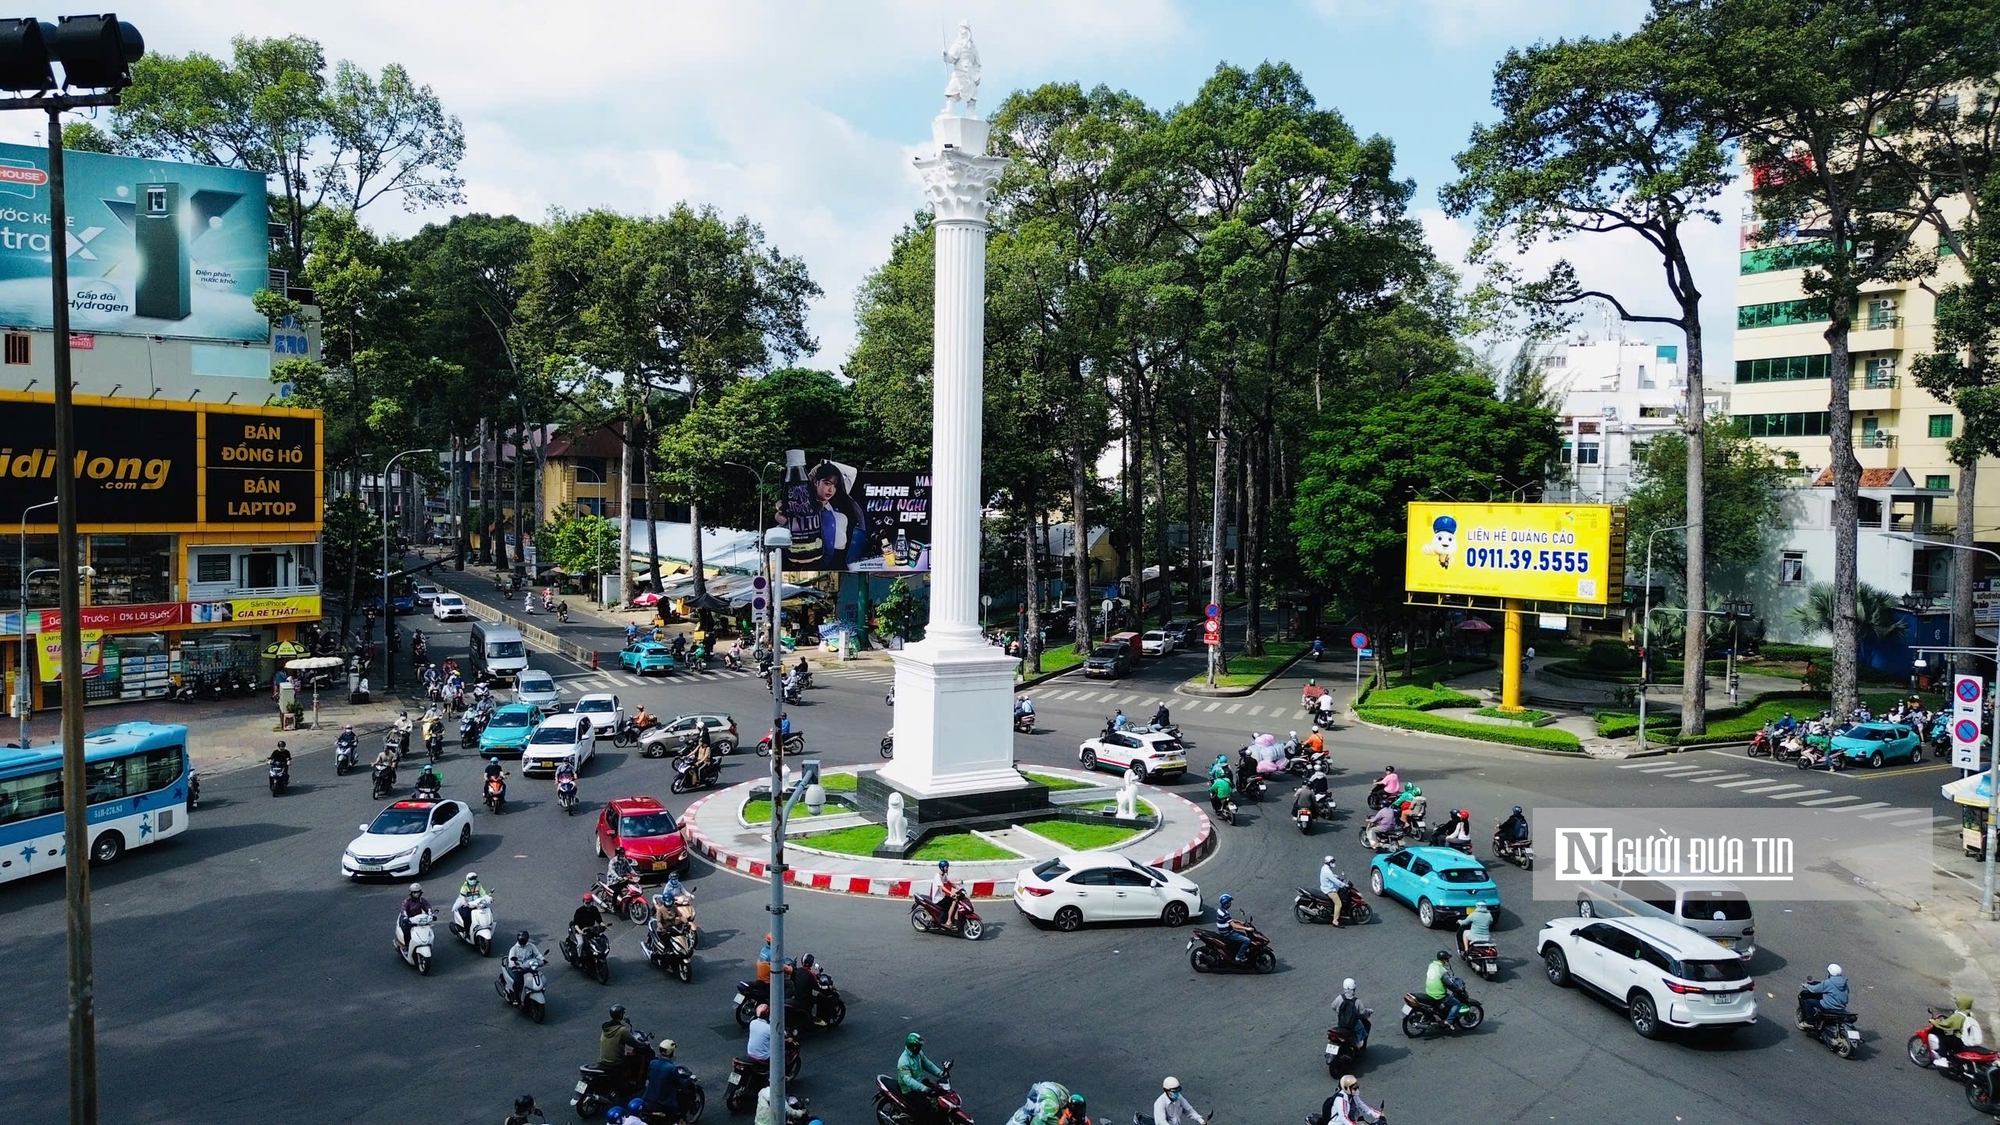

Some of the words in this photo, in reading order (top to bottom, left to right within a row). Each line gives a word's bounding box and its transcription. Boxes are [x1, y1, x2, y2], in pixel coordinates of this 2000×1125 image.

[33, 212, 75, 227] KHE
[76, 290, 98, 301] Gấp
[99, 292, 117, 301] đôi
[67, 299, 129, 313] Hydrogen
[244, 422, 281, 441] BÁN
[221, 441, 274, 462] ĐỒNG
[278, 444, 303, 463] HỒ
[100, 480, 137, 490] .com
[243, 477, 280, 494] BÁN
[865, 485, 910, 497] SHAKE
[228, 501, 297, 516] LAPTOP
[899, 511, 927, 522] OFF
[1467, 528, 1490, 542] LIÊN
[1493, 528, 1507, 544] HỆ
[1511, 529, 1548, 544] QUẢNG
[1552, 529, 1574, 545] CÁO
[1466, 547, 1589, 573] 0911.39.5555
[82, 613, 110, 623] Trước
[119, 613, 134, 621] 0%
[134, 612, 148, 620] Lãi
